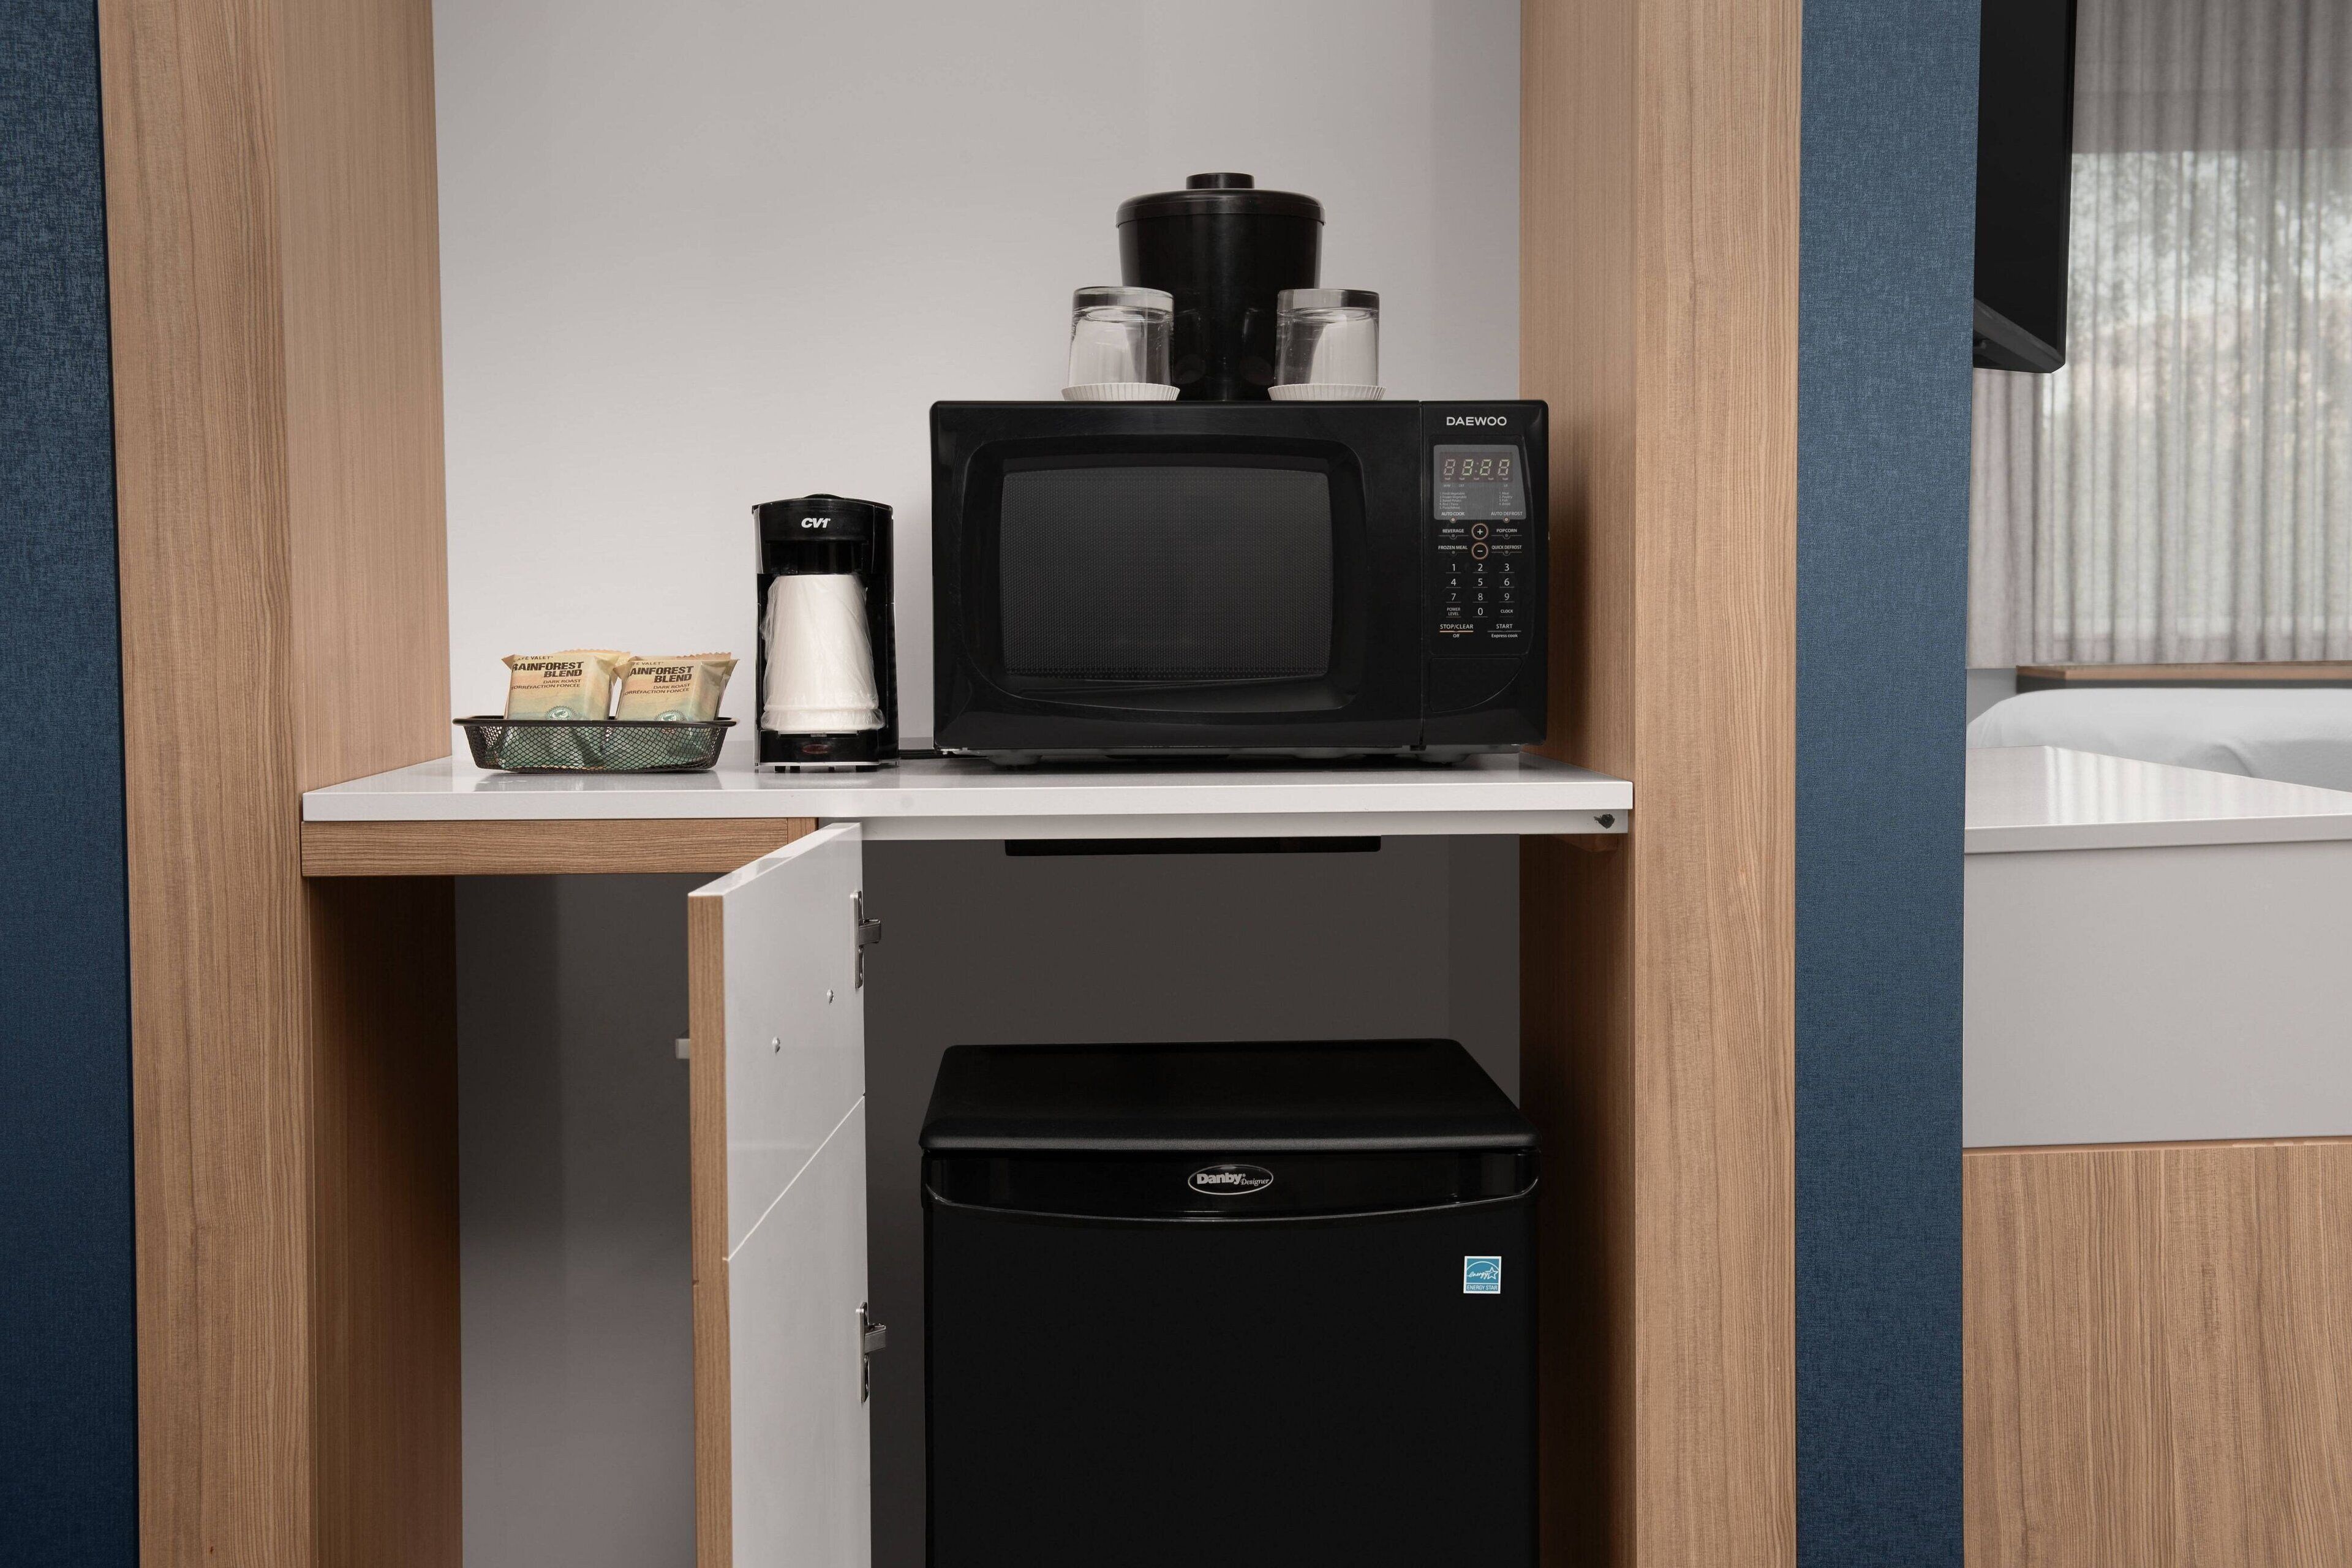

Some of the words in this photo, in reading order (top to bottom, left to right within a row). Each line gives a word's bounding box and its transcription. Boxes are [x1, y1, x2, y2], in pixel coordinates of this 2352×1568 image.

[1446, 417, 1507, 426] DAEWOO
[630, 666, 694, 676] AINFOREST
[654, 674, 692, 683] BLEND
[1197, 1172, 1242, 1185] Danby
[1240, 1178, 1270, 1186] Designer
